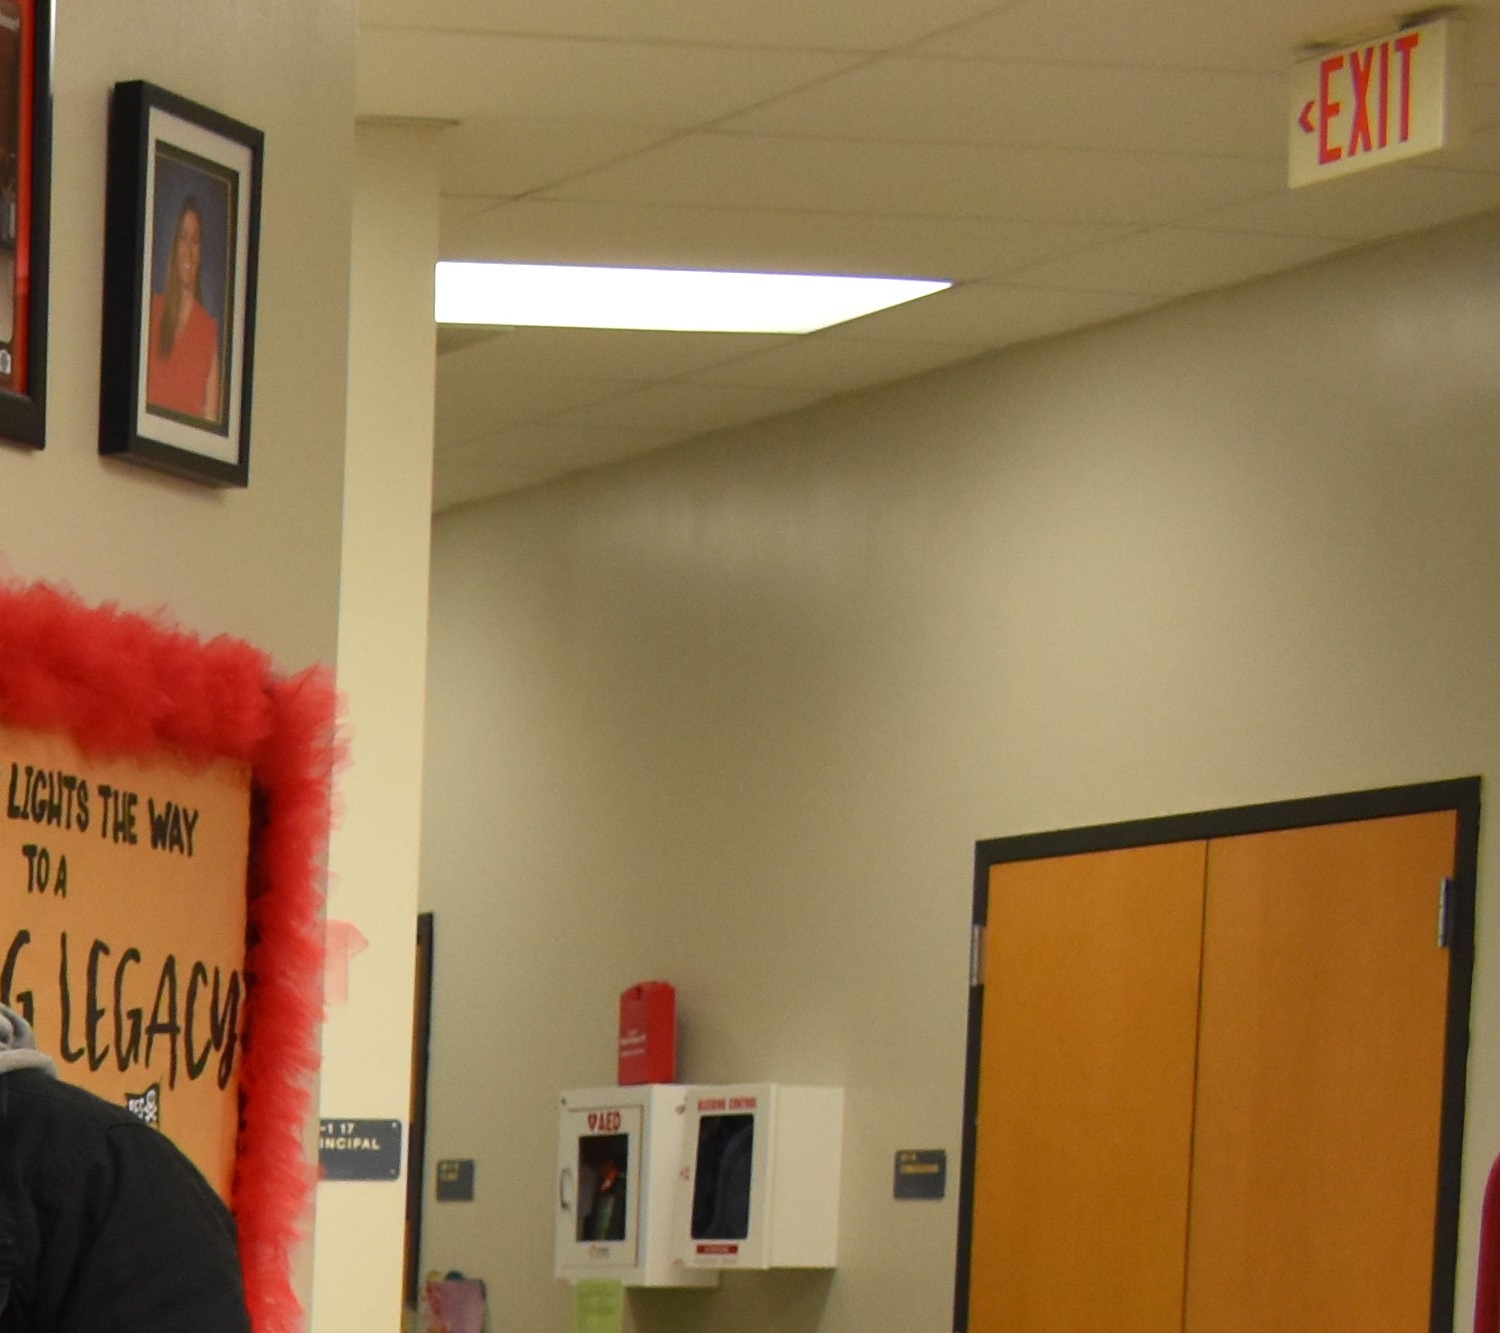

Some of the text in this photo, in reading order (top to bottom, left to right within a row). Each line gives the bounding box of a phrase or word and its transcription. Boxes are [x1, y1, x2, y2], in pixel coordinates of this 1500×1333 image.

[1318, 33, 1419, 165] EXIT
[7, 763, 89, 833] LIGHTS
[97, 784, 138, 845] THE
[148, 798, 199, 857] WAY
[22, 844, 68, 898] TO A
[320, 1138, 380, 1150] INCIPAL
[596, 1112, 622, 1131] AED
